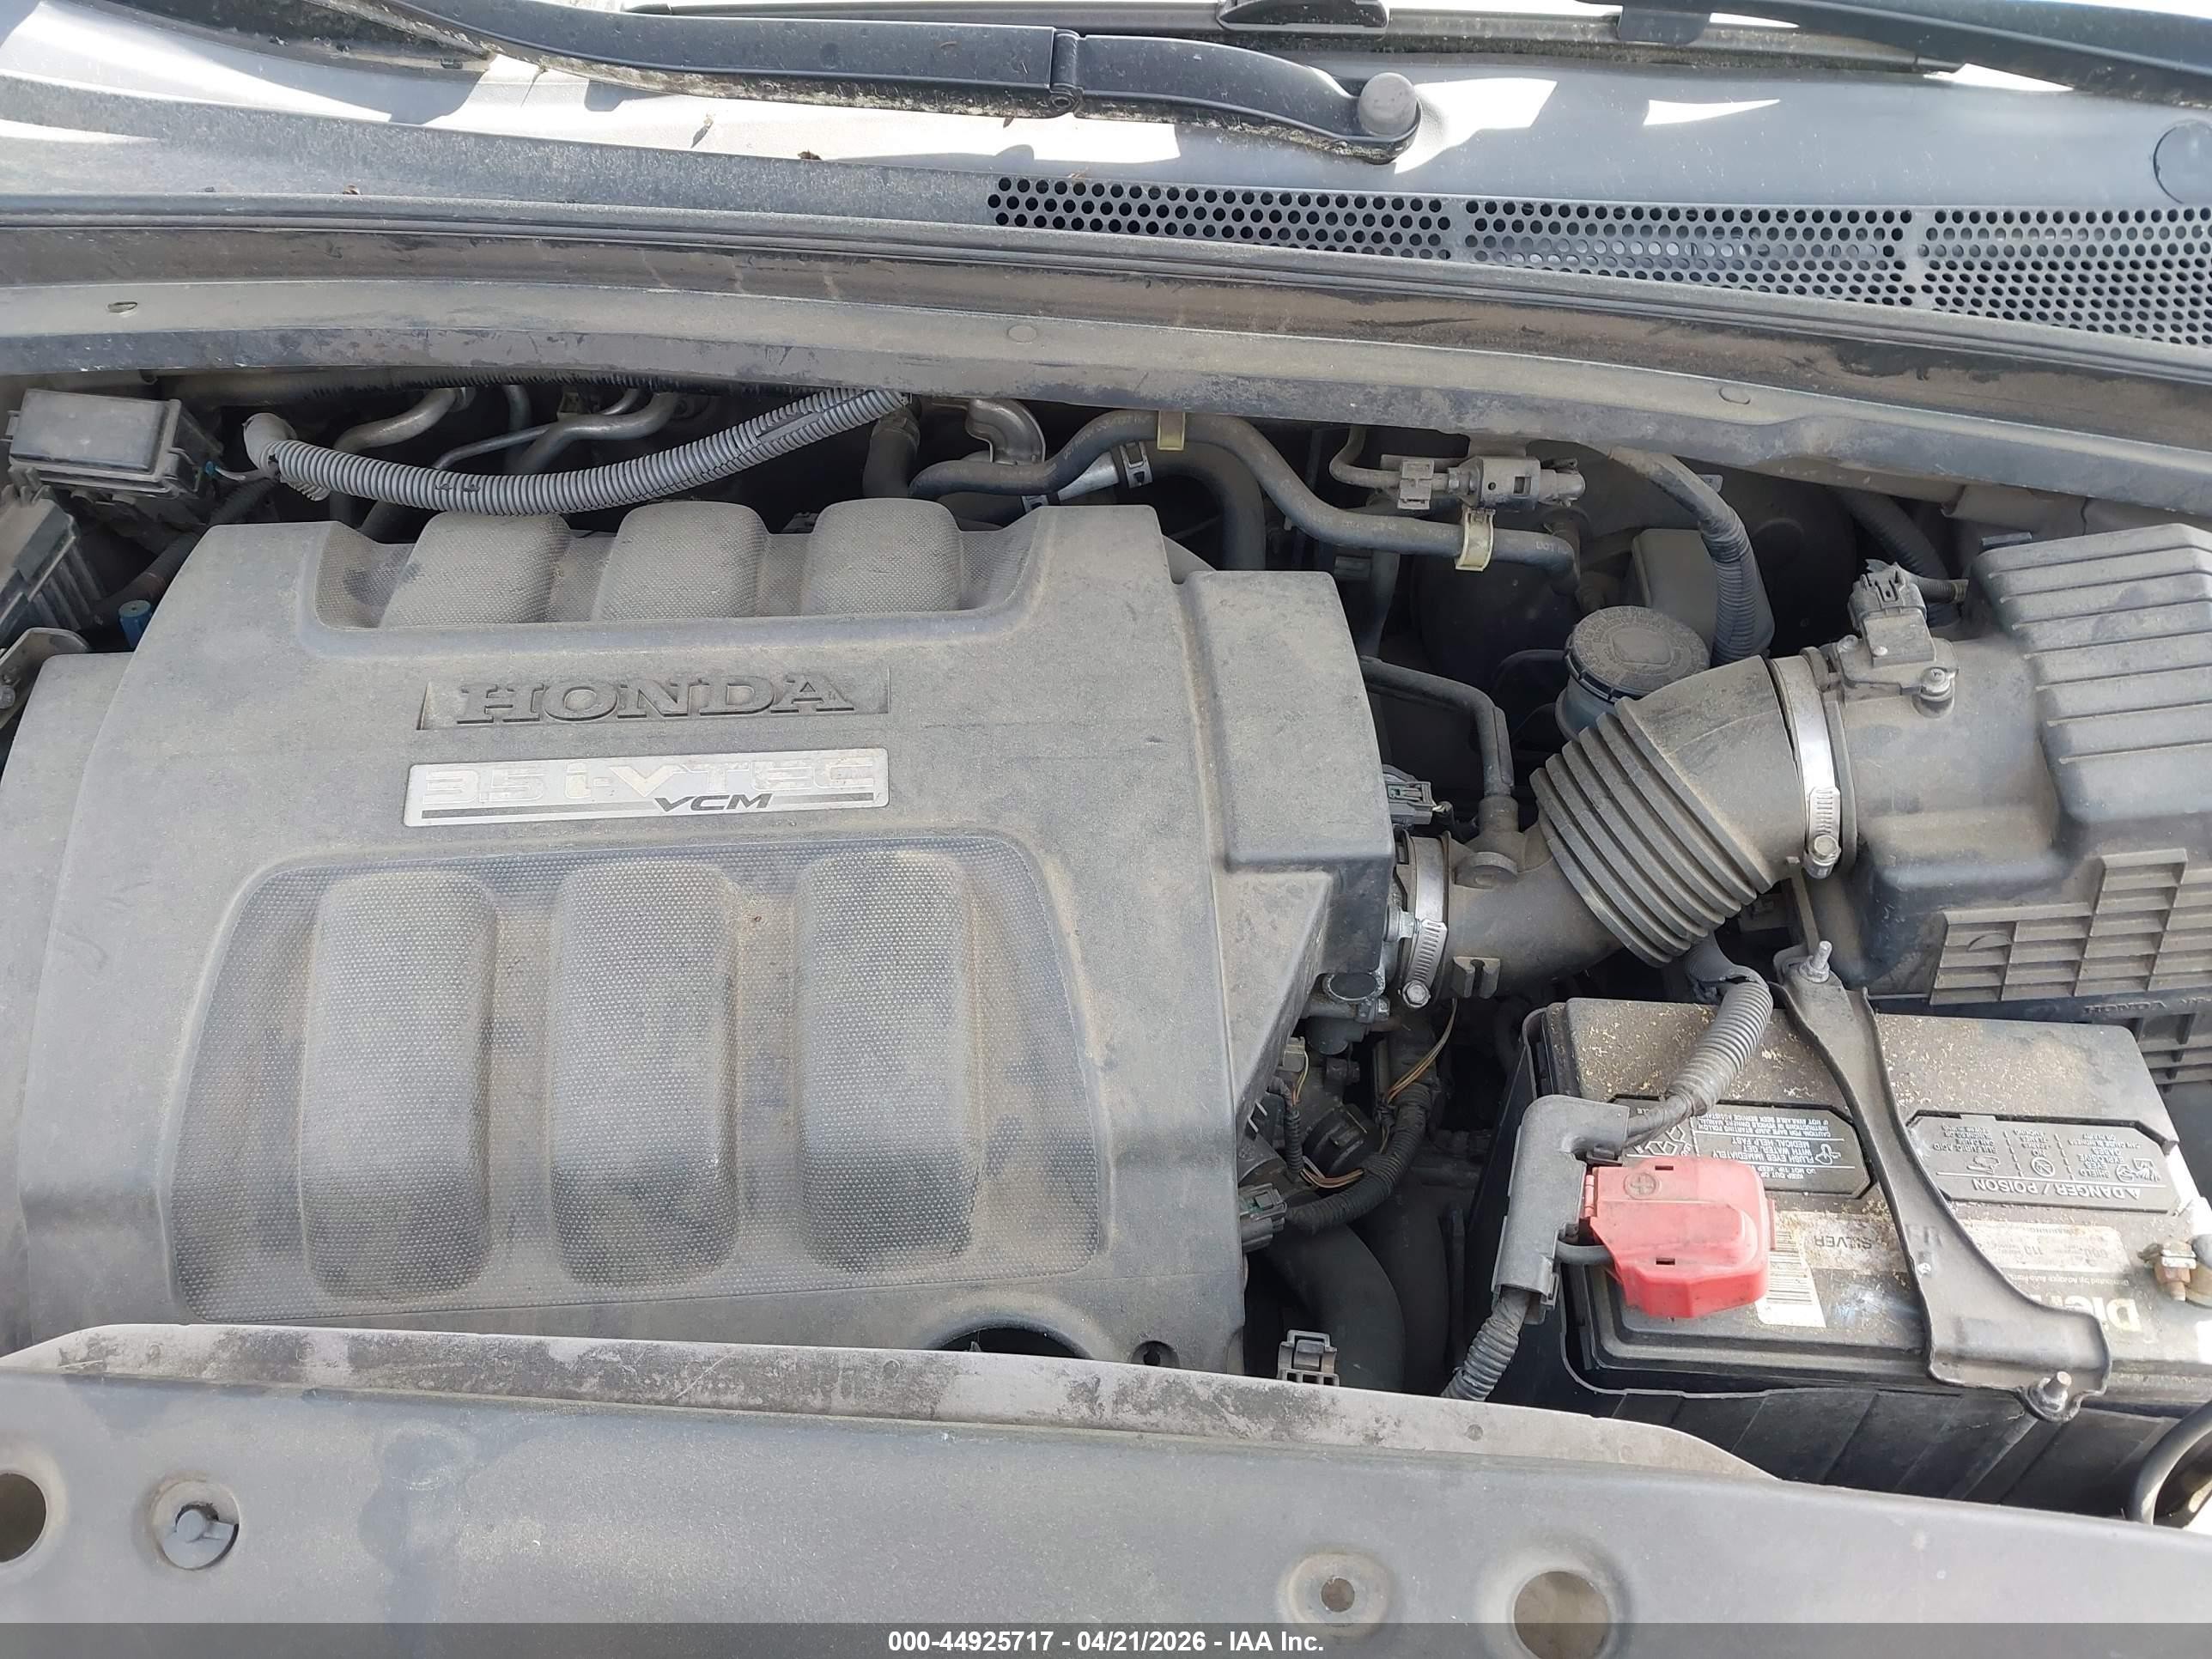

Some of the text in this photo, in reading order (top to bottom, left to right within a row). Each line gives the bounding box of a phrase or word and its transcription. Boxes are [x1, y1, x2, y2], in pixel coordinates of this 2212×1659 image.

[456, 672, 854, 724] HONDA
[564, 756, 876, 800] i-VTEC
[653, 793, 774, 813] VCM
[1731, 1137, 1751, 1146] FAST
[1776, 1139, 1809, 1147] MEDICAL
[1711, 1150, 1764, 1161] IMMEDIATELY
[1788, 1154, 1814, 1163] FLUSH
[2076, 1154, 2123, 1164] EXPLOSIVE
[2083, 1161, 2107, 1170] EYES
[2079, 1169, 2109, 1178] SHIELD
[1972, 1178, 2038, 1195] POISON
[2054, 1183, 2125, 1199] DANGER
[1814, 1236, 1872, 1250] SILVER
